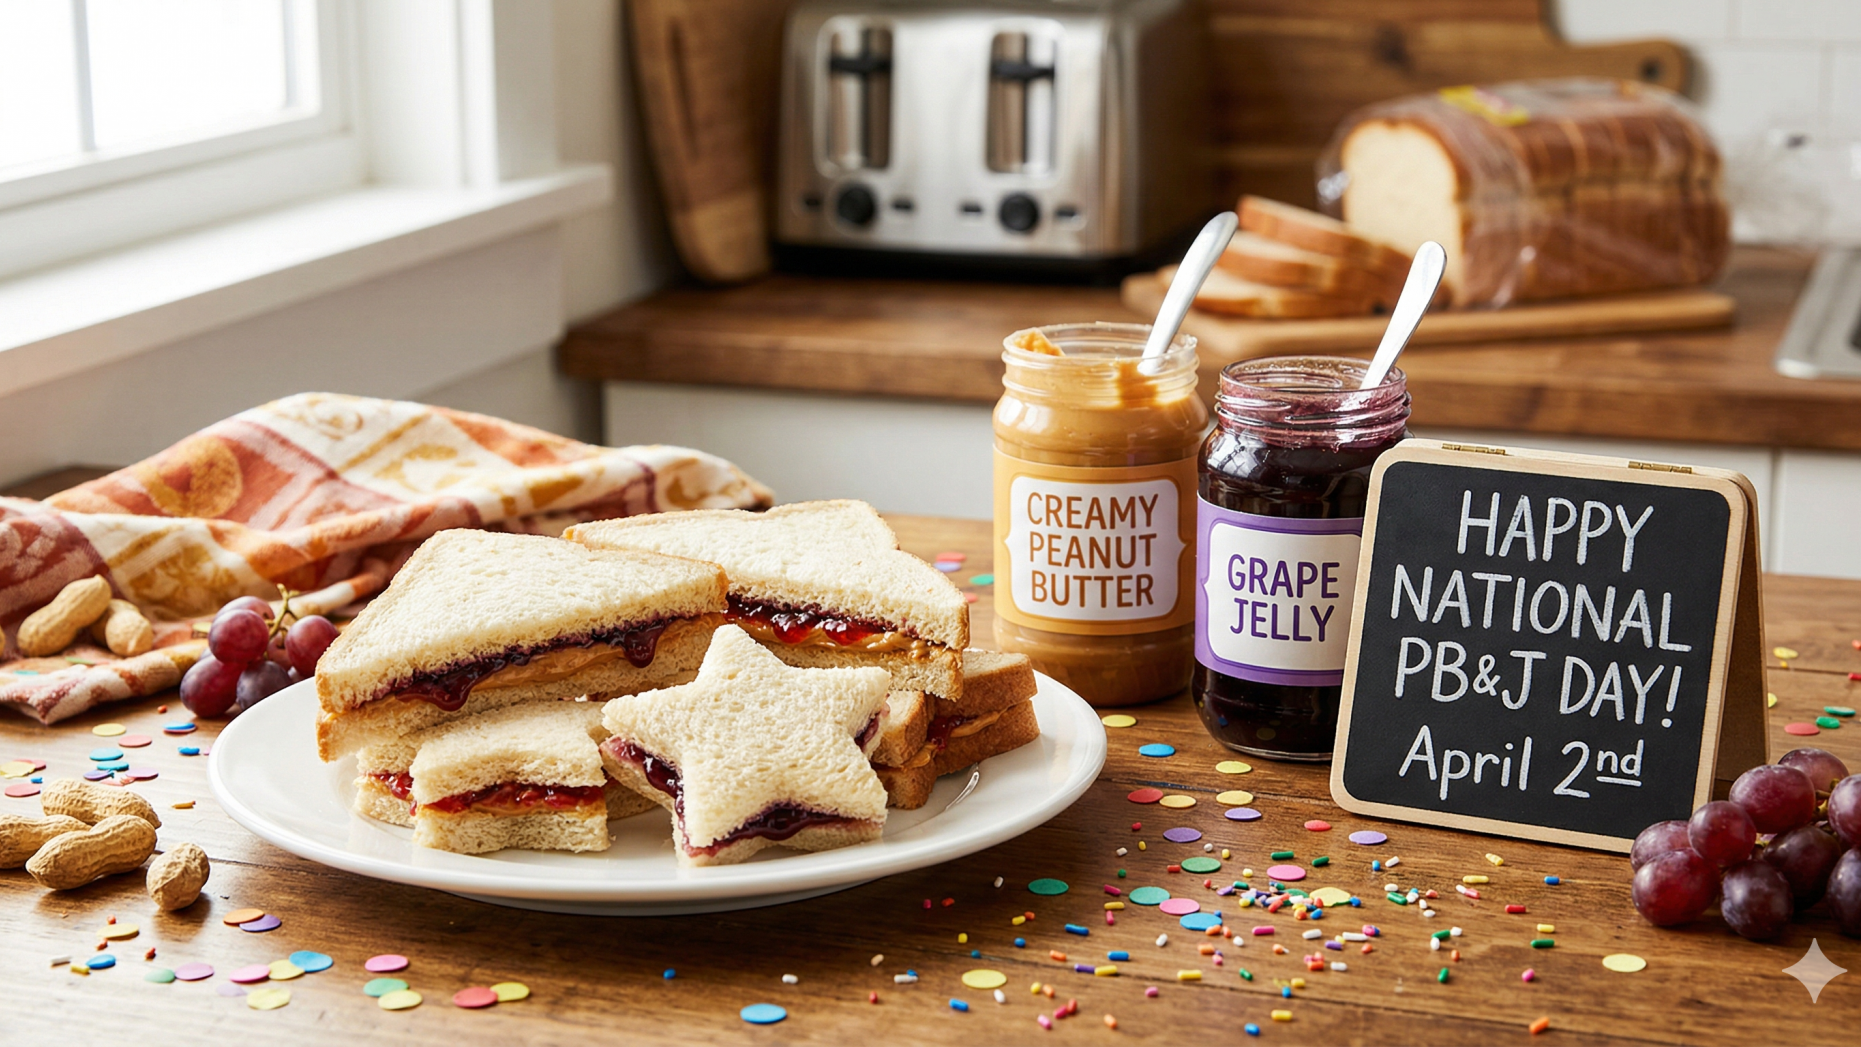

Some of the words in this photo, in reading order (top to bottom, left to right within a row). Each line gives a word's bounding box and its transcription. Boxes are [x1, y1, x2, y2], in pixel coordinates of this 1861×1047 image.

[1027, 492, 1159, 531] CREAMY
[1457, 489, 1655, 573] HAPPY
[1029, 531, 1158, 569] PEANUT
[1031, 570, 1154, 609] BUTTER
[1227, 554, 1340, 599] GRAPE
[1229, 598, 1336, 643] JELLY
[1390, 563, 1692, 652] NATIONAL
[1394, 636, 1547, 710] PB&J
[1559, 655, 1682, 728] DAY!
[1398, 724, 1533, 801] April
[1553, 738, 1645, 798] 2nd
